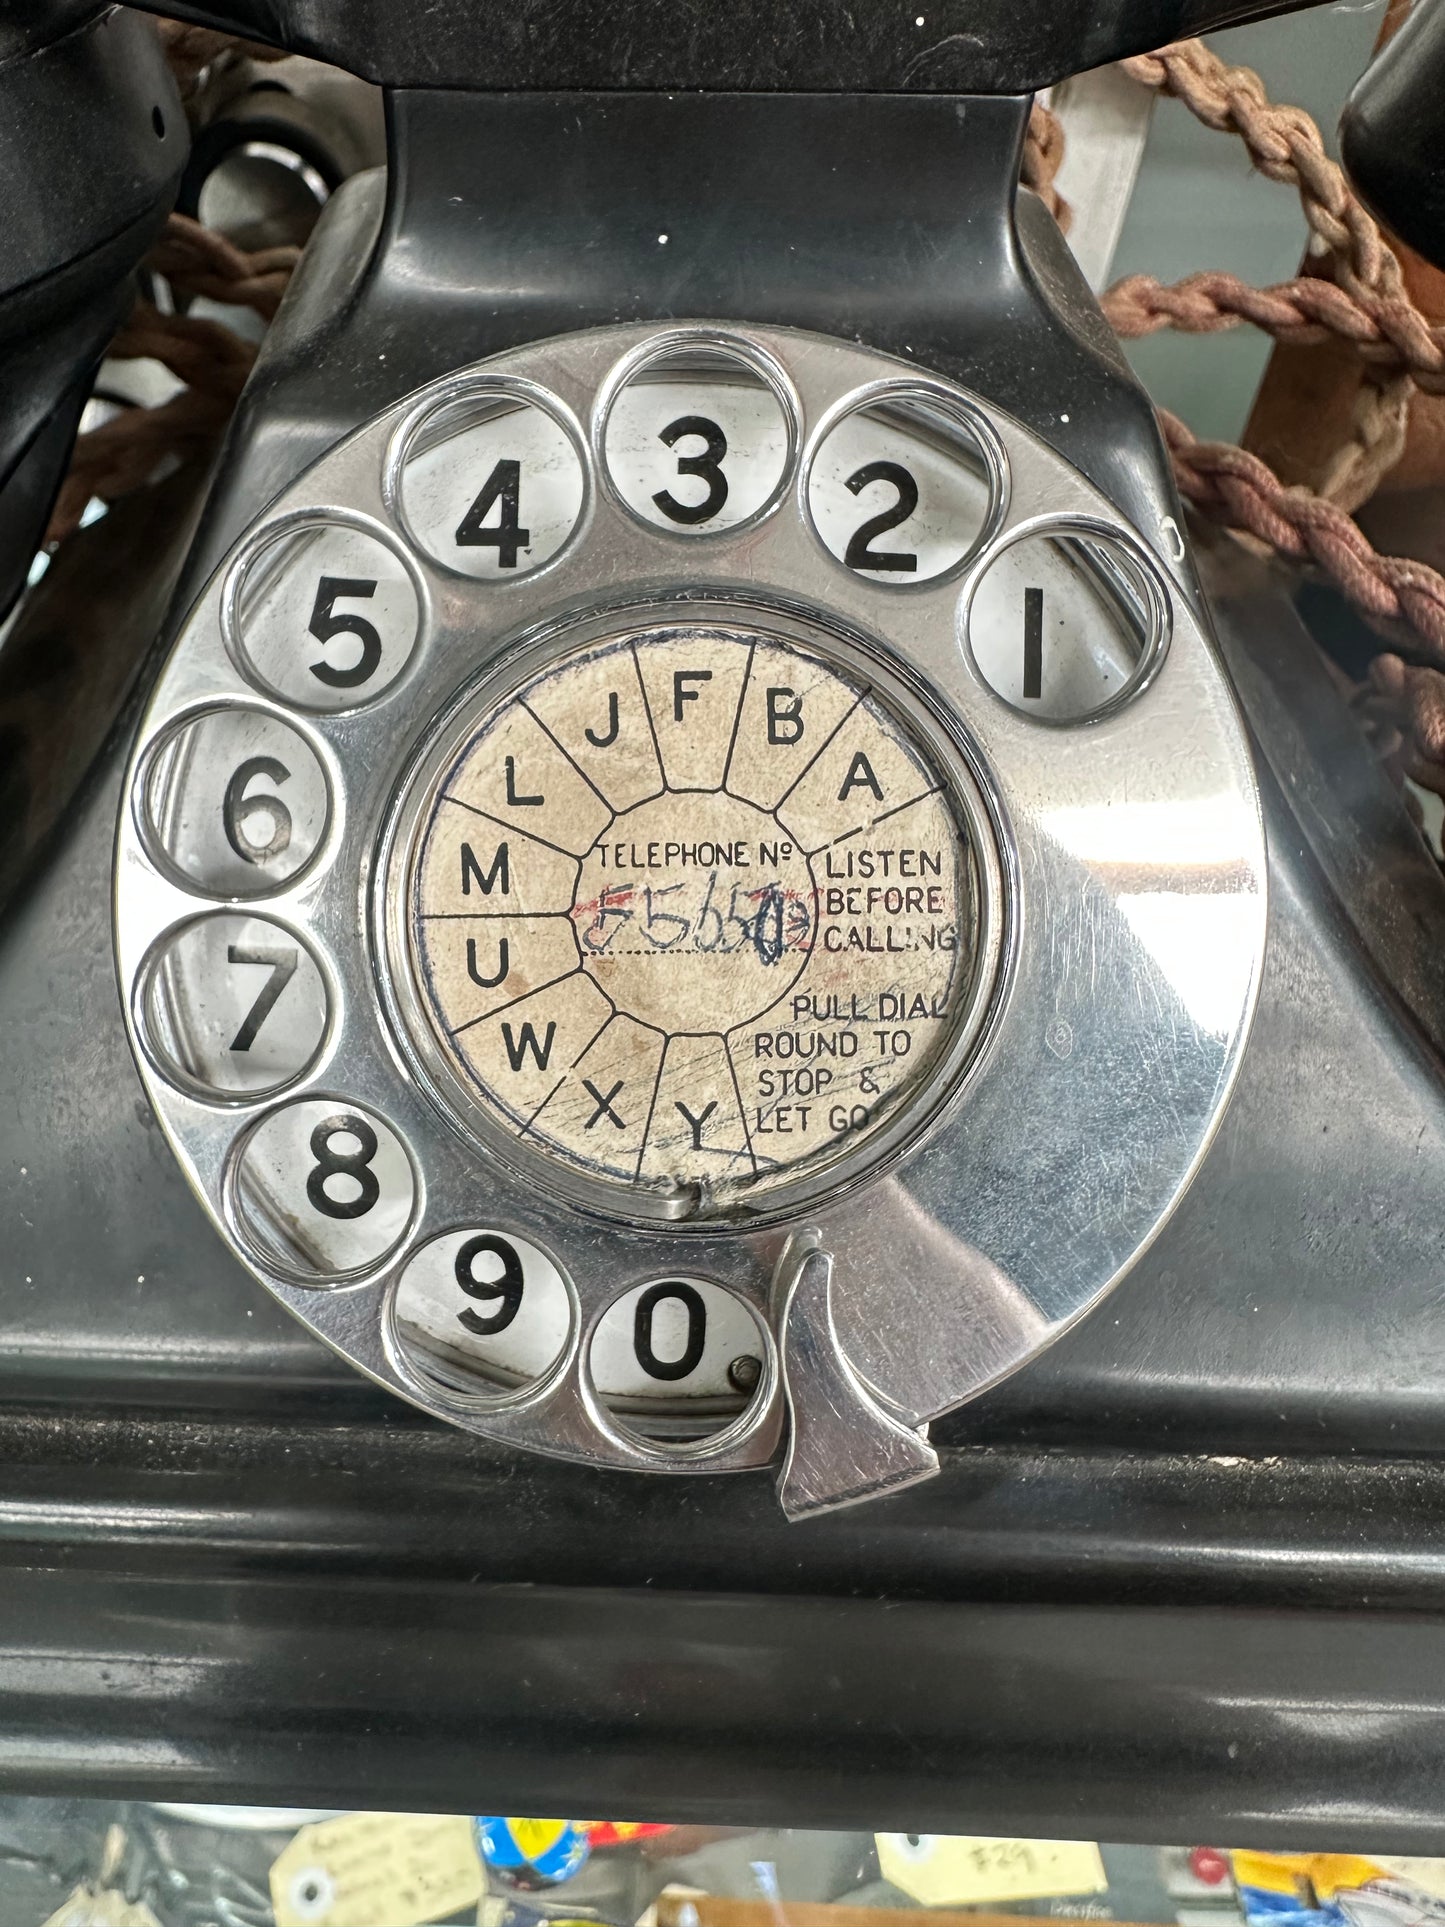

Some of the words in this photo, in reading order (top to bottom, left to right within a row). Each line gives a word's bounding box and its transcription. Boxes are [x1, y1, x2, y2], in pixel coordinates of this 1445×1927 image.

[652, 416, 729, 526] 3
[456, 459, 530, 569] 4
[844, 461, 918, 573] 2
[308, 577, 384, 688] 5
[584, 692, 619, 747] J
[674, 670, 712, 721] F
[767, 687, 804, 745] B
[505, 756, 545, 806] L
[838, 751, 884, 801] A
[223, 755, 292, 864] 6
[461, 843, 509, 895] M
[596, 841, 750, 869] TELEPHONE
[825, 849, 942, 879] LISTEN
[825, 885, 943, 916] BEFORE
[466, 938, 509, 988] U
[227, 945, 297, 1052] 7
[792, 992, 868, 1022] PULL
[877, 992, 949, 1021] DIAL
[501, 1021, 555, 1071] W
[754, 1030, 858, 1059] ROUND
[872, 1030, 912, 1056] TO
[582, 1079, 625, 1130] X
[758, 1067, 833, 1097] STOP
[858, 1066, 880, 1095] &
[674, 1101, 719, 1151] Y
[755, 1105, 811, 1134] LET
[828, 1104, 870, 1133] GO
[306, 1115, 379, 1220] 8
[454, 1234, 525, 1335] 9
[634, 1282, 706, 1381] 0
